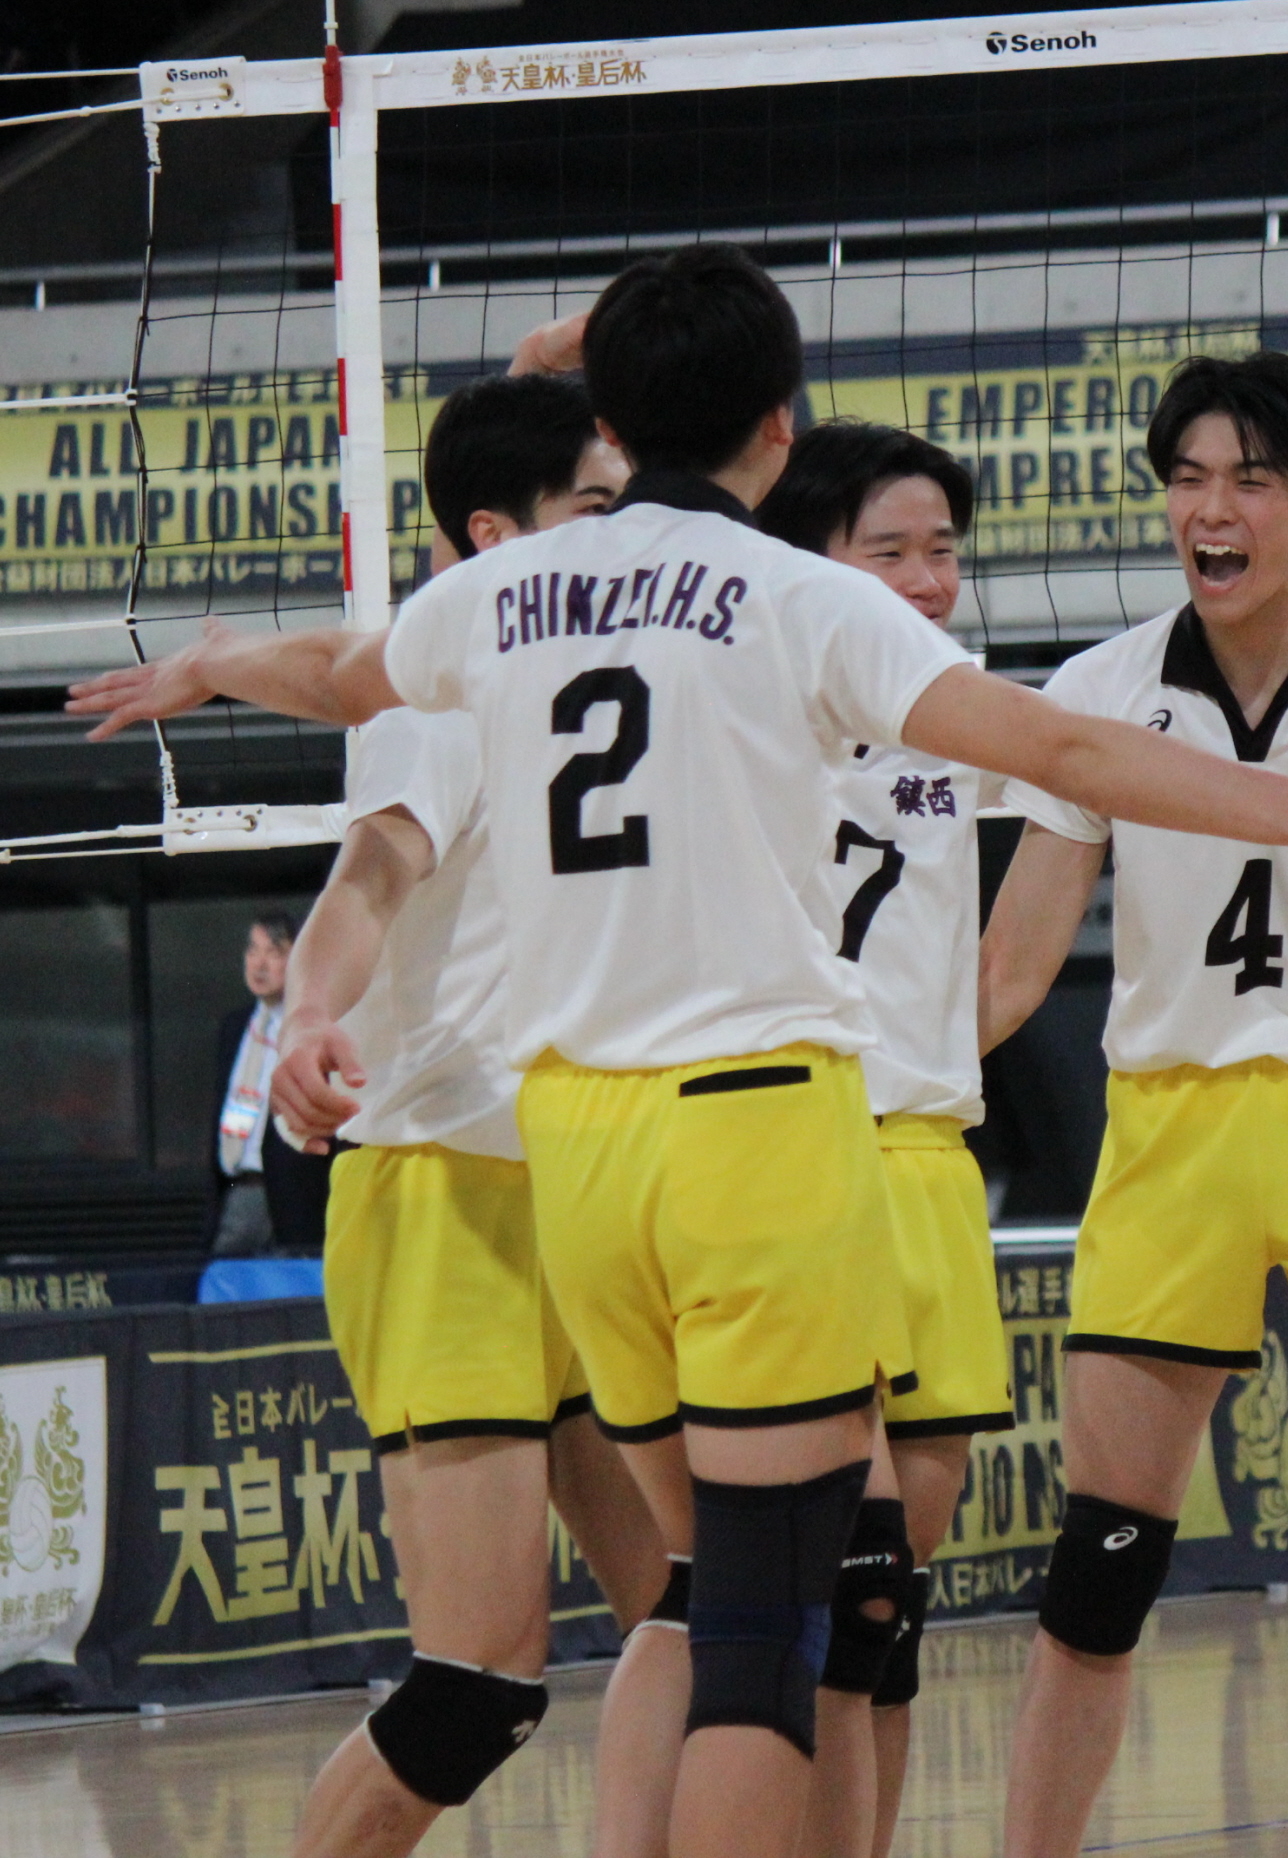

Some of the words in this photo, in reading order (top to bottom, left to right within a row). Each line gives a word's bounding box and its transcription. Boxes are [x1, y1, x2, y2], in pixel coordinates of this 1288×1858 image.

[180, 67, 228, 81] Senoh
[1011, 30, 1097, 53] Senoh
[927, 374, 1158, 441] EMPERO
[49, 422, 146, 478] ALL
[958, 447, 1153, 512] MPRES
[0, 480, 421, 549] HAMPIONSP
[548, 664, 651, 876] 2
[833, 818, 906, 964] 7
[1204, 857, 1284, 997] 4
[210, 1380, 363, 1441] 全日本バレー
